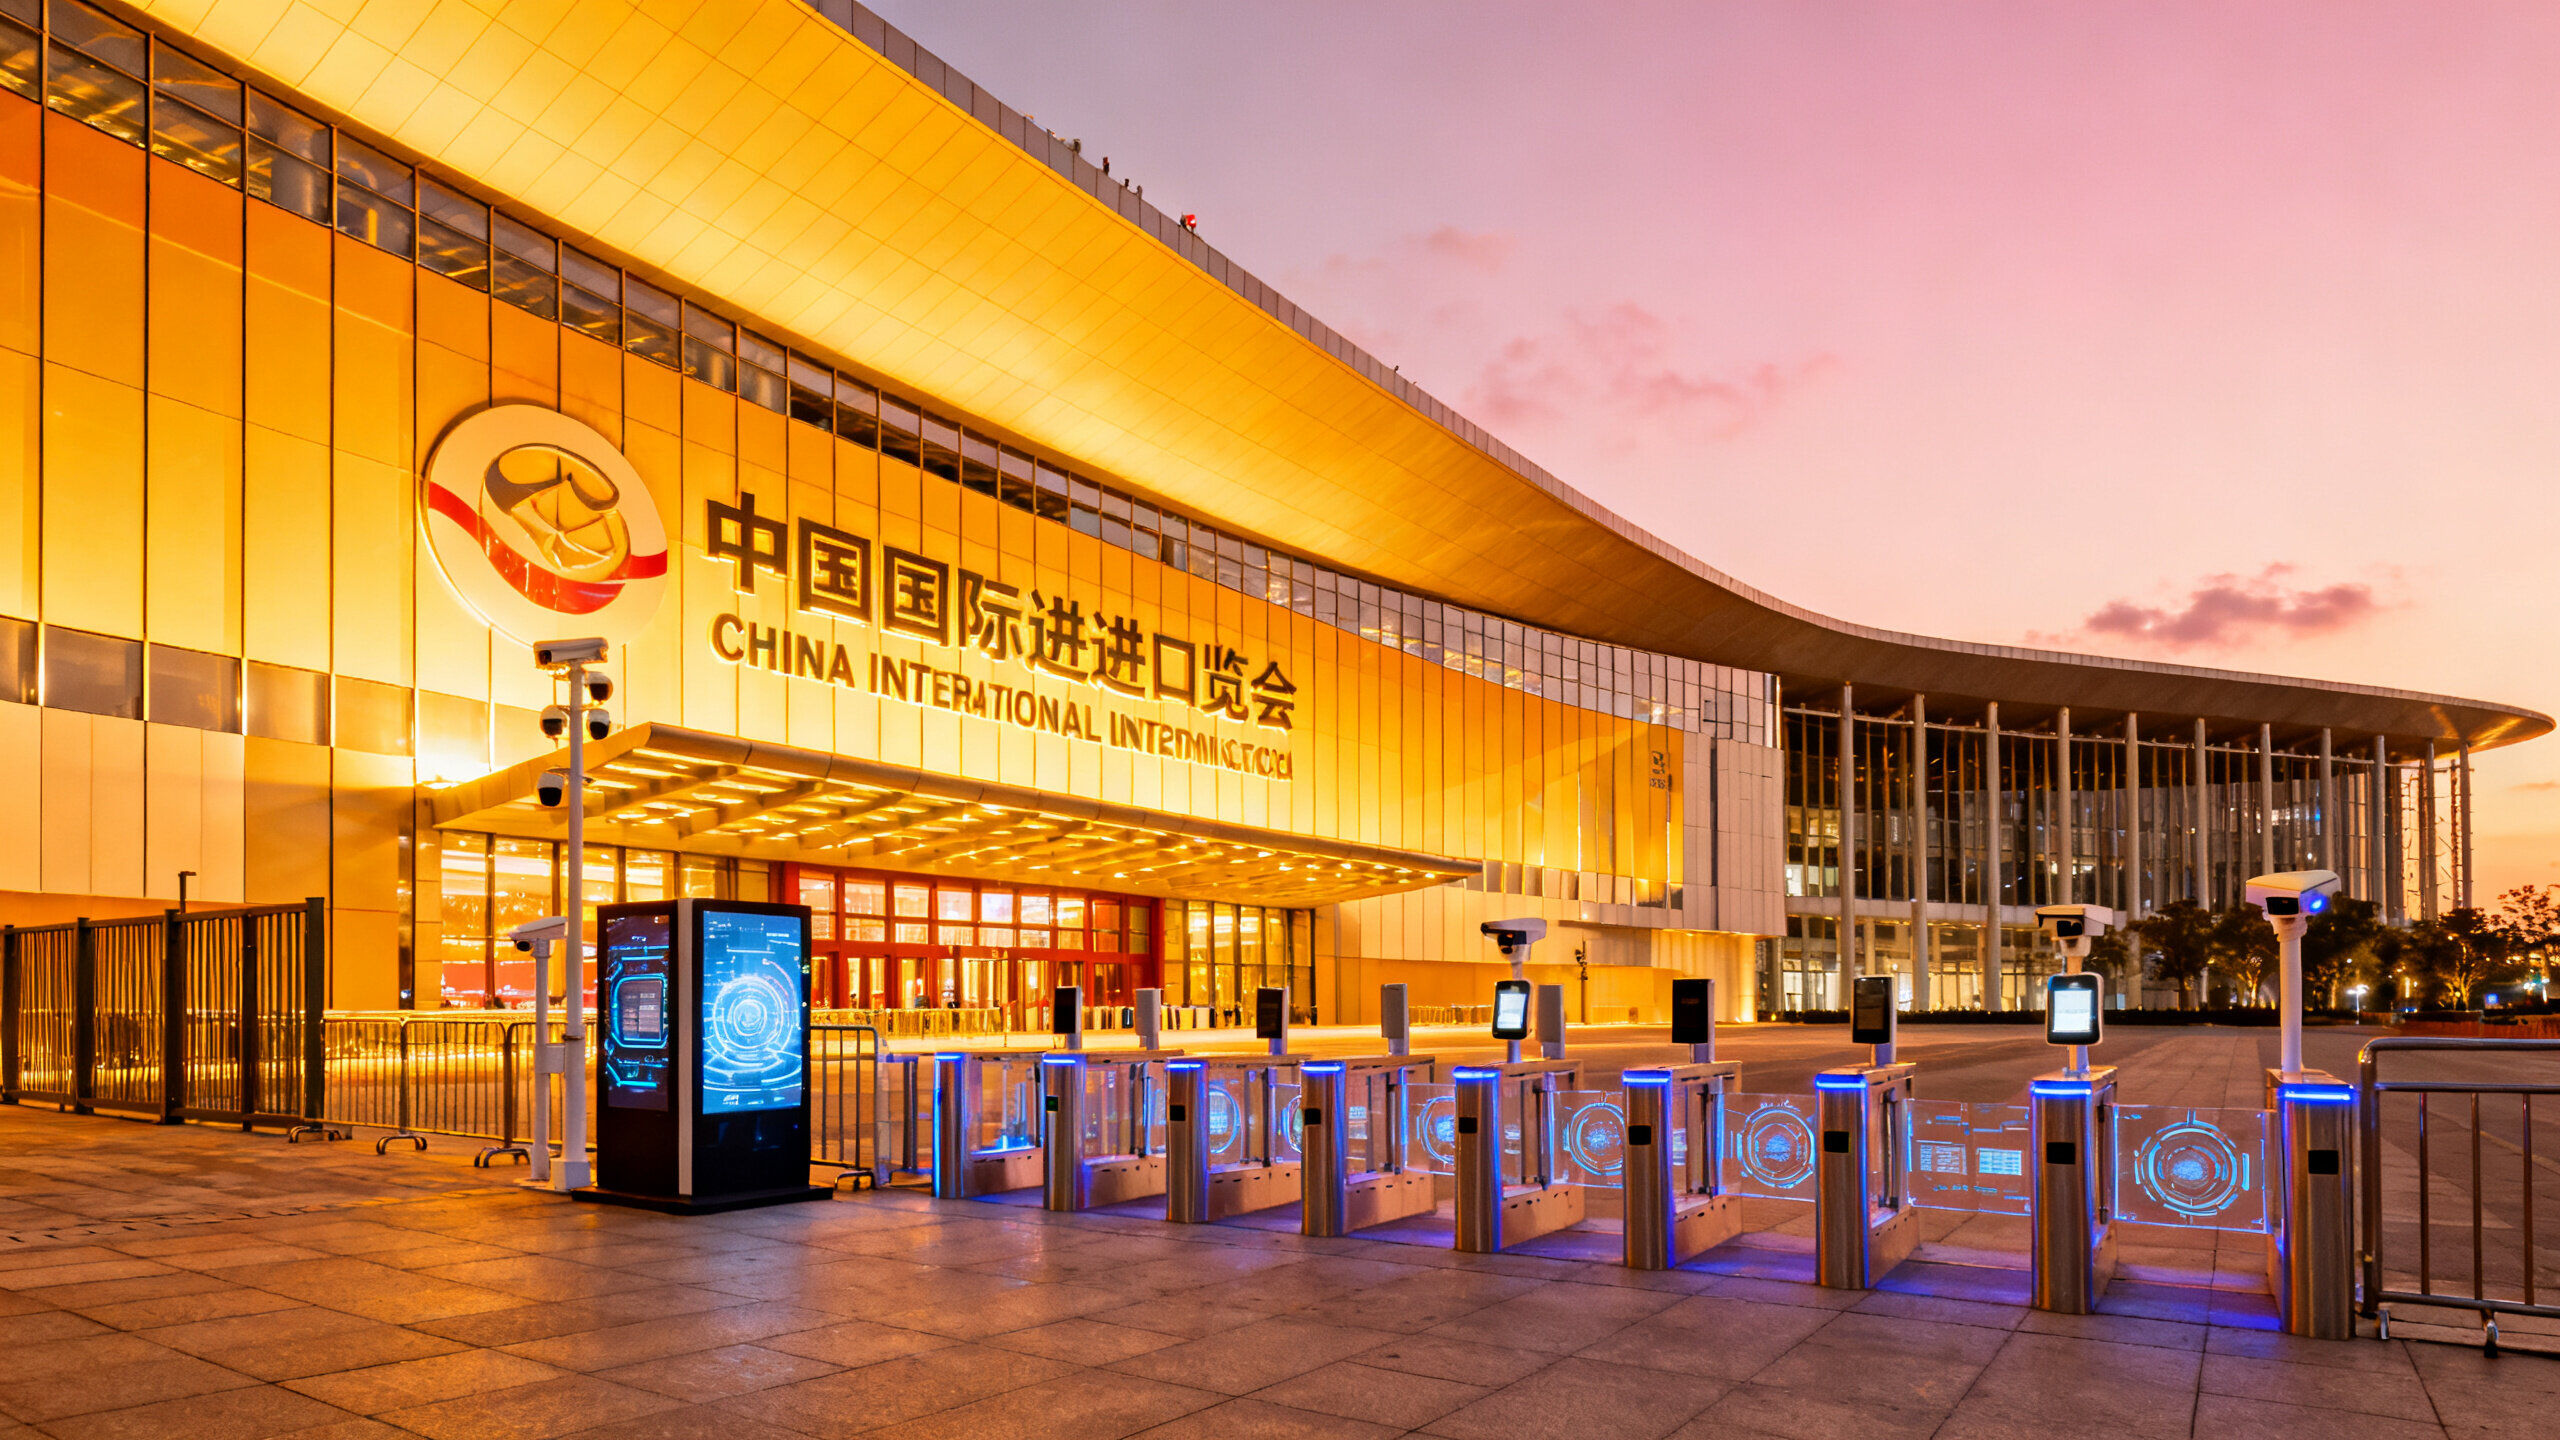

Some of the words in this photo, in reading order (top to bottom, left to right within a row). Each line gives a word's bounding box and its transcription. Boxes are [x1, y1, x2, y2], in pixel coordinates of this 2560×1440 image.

[706, 491, 1297, 731] 中国国际进进口览会
[711, 612, 855, 689] CHINA
[868, 652, 1102, 743] INTERATIONAL
